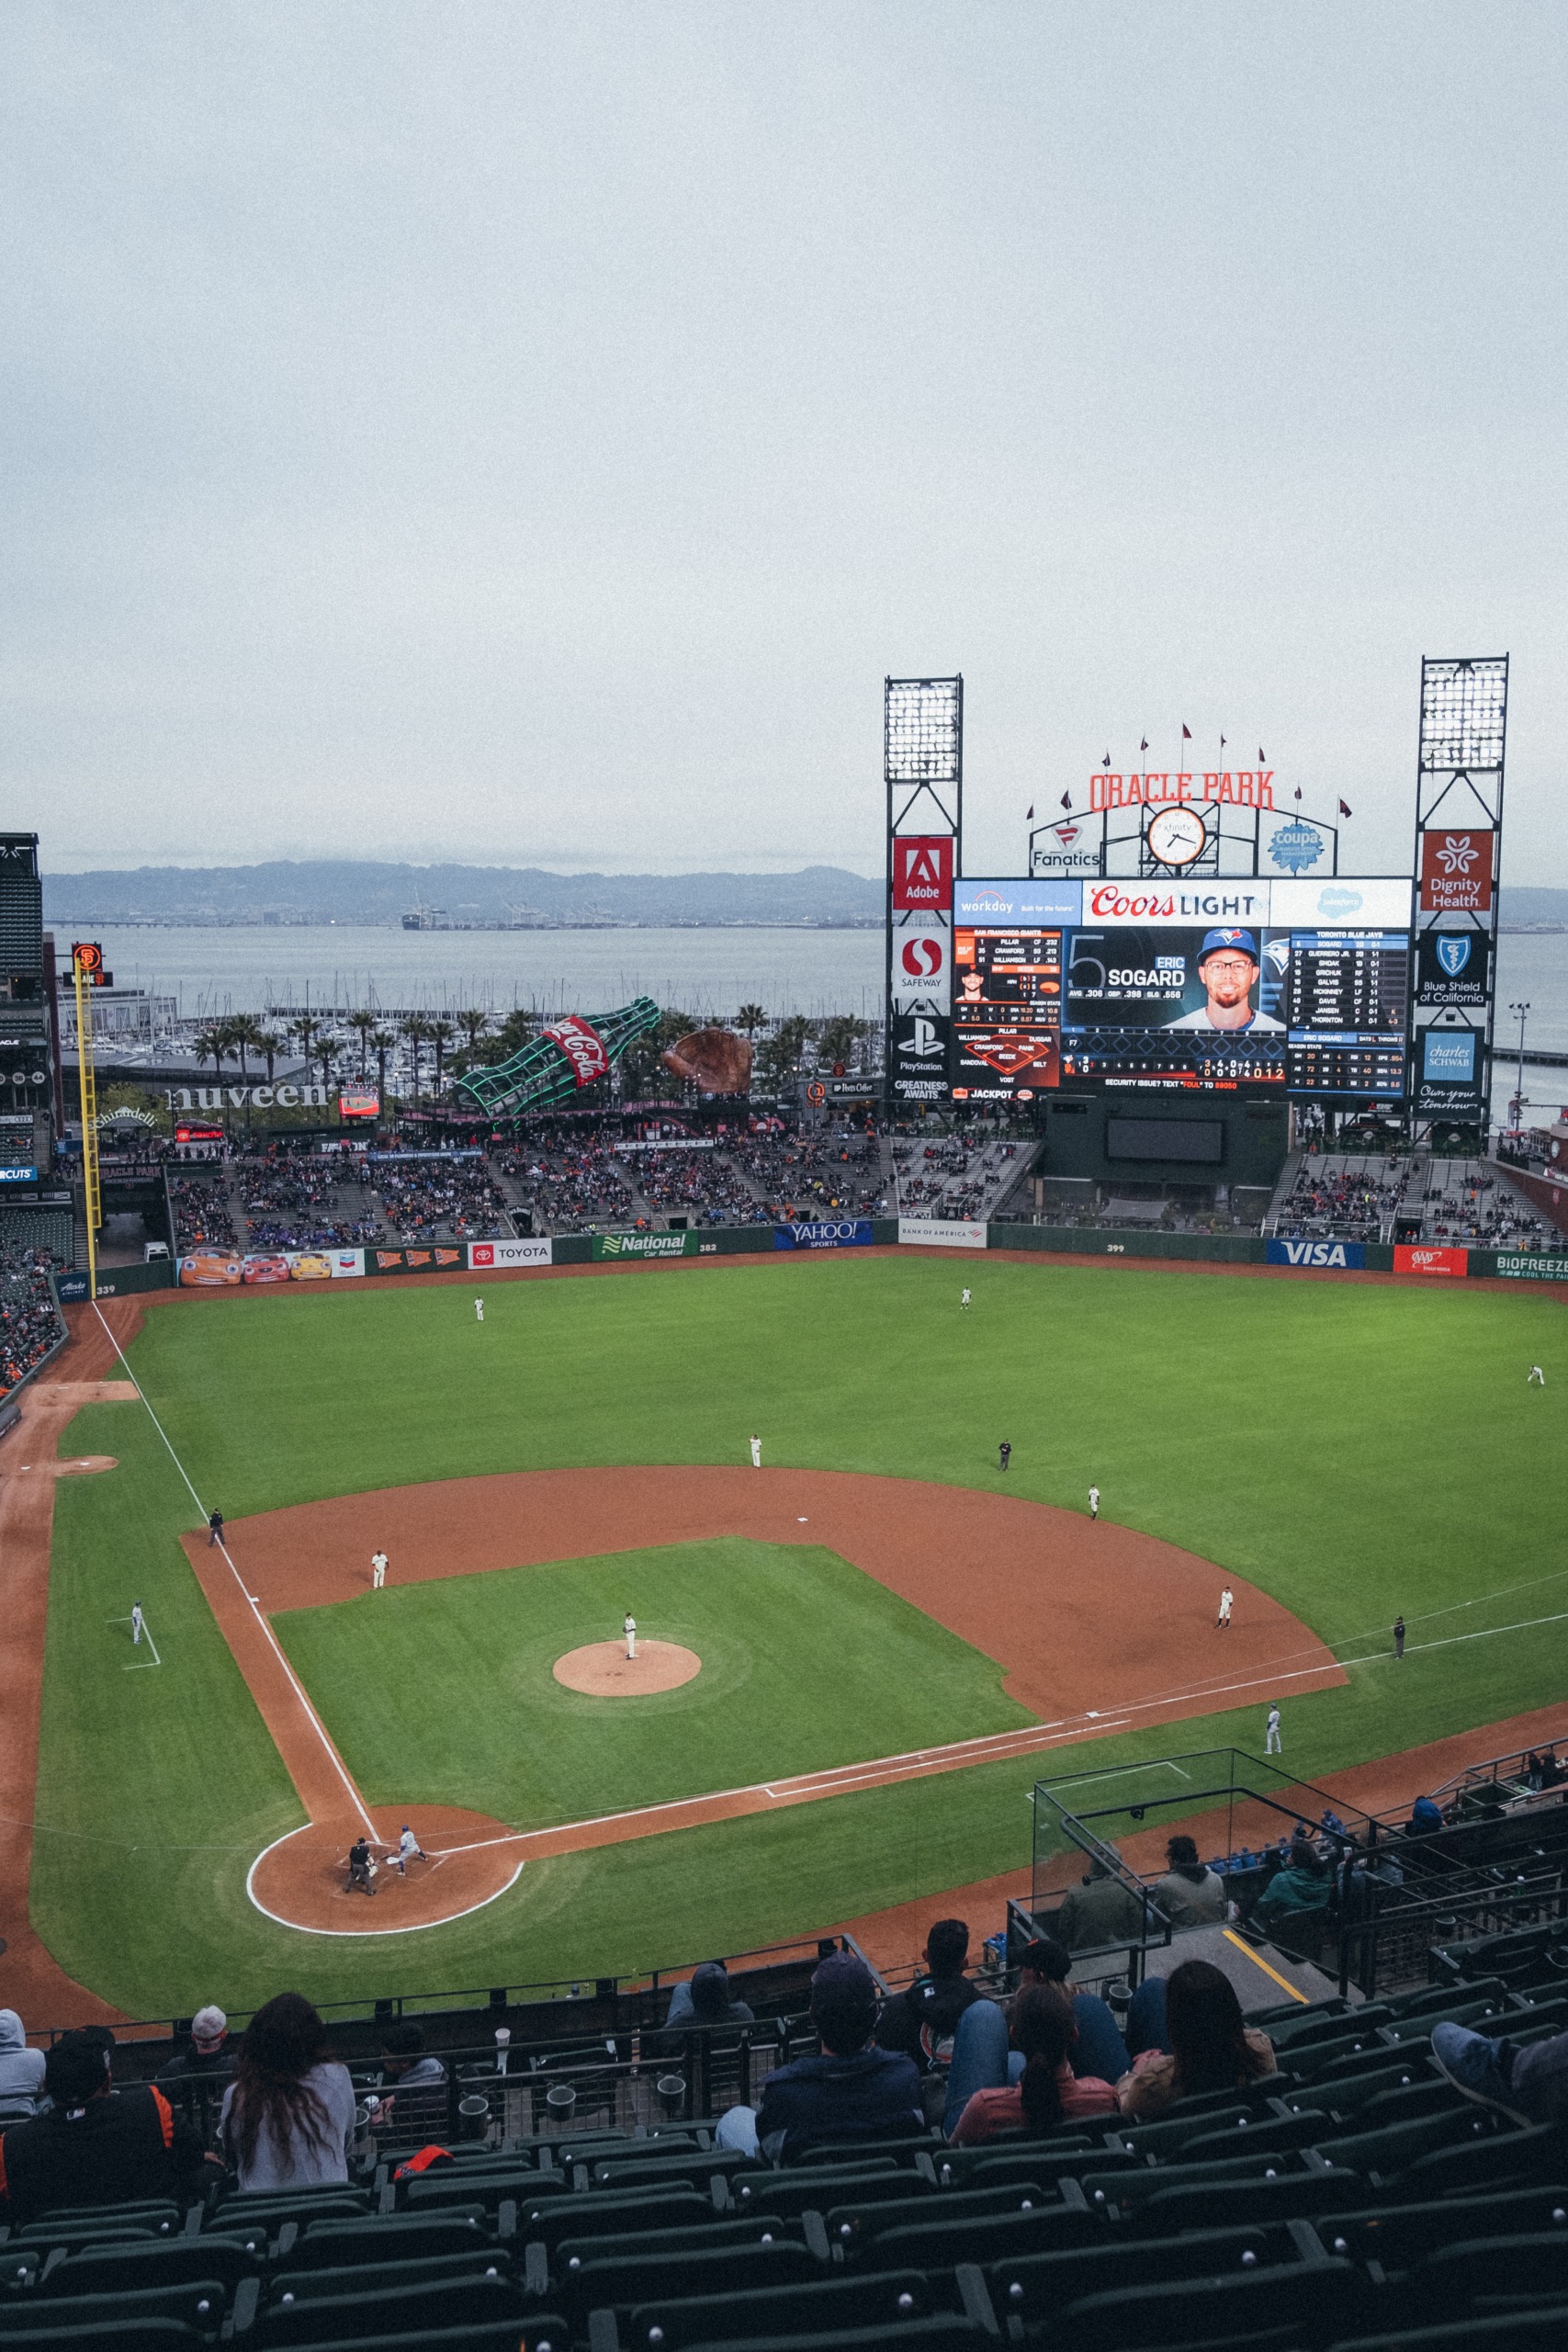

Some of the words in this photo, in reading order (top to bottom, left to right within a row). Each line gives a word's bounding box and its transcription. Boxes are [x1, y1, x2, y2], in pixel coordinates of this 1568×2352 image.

[1089, 773, 1192, 813] ORACLE
[1202, 772, 1275, 810] PARK
[1276, 832, 1318, 847] coupa
[1033, 851, 1100, 866] Fanatics
[1430, 878, 1482, 895] Dignity
[906, 886, 940, 899] Adobe
[961, 900, 1013, 914] workday
[1091, 886, 1177, 917] Coors
[1180, 896, 1255, 916] LIGHT
[1432, 895, 1480, 908] Health
[1067, 934, 1106, 989] 5
[1157, 956, 1185, 969] ERIC
[901, 978, 942, 988] SAFEWAY
[1108, 968, 1185, 987] SOGARD
[1424, 981, 1446, 991] Blue
[1449, 981, 1481, 992] Shield
[1419, 992, 1431, 1002] of
[1433, 992, 1484, 1002] California
[1429, 1045, 1470, 1057] charles
[1082, 1056, 1089, 1064] 3
[1217, 1059, 1224, 1068] 4
[1230, 1059, 1236, 1068] 0
[1244, 1060, 1250, 1069] 4
[1429, 1058, 1470, 1067] SCHWAB
[1082, 1065, 1089, 1073] 0
[1204, 1068, 1211, 1076] 0
[1217, 1069, 1224, 1077] 0
[1230, 1069, 1236, 1077] 0
[1244, 1069, 1250, 1078] 4
[1253, 1068, 1262, 1079] 0
[1265, 1069, 1271, 1079] 1
[1275, 1069, 1283, 1079] 2
[855, 1082, 873, 1093] Coffee
[895, 1080, 949, 1091] GREATNESS
[1137, 1080, 1161, 1088] ISSUE?
[165, 1083, 329, 1111] nuveen
[904, 1090, 942, 1099] AWAITS.
[970, 1090, 1013, 1099] JACKPOT
[1420, 1085, 1446, 1097] Own
[1447, 1091, 1477, 1103] your
[1418, 1098, 1478, 1109] tomorrow
[0, 1170, 31, 1180] RCUTS
[791, 1221, 858, 1242] YAHOO!
[621, 1233, 686, 1251] National
[699, 1243, 717, 1252] 382
[810, 1240, 838, 1249] SPORTS
[498, 1247, 548, 1260] TOYOTA
[659, 1249, 683, 1257] Rental
[1107, 1243, 1125, 1253] 399
[1280, 1241, 1347, 1267] VISA
[1413, 1252, 1433, 1262] AAA
[60, 1281, 86, 1291] Alaska
[96, 1285, 116, 1295] 339
